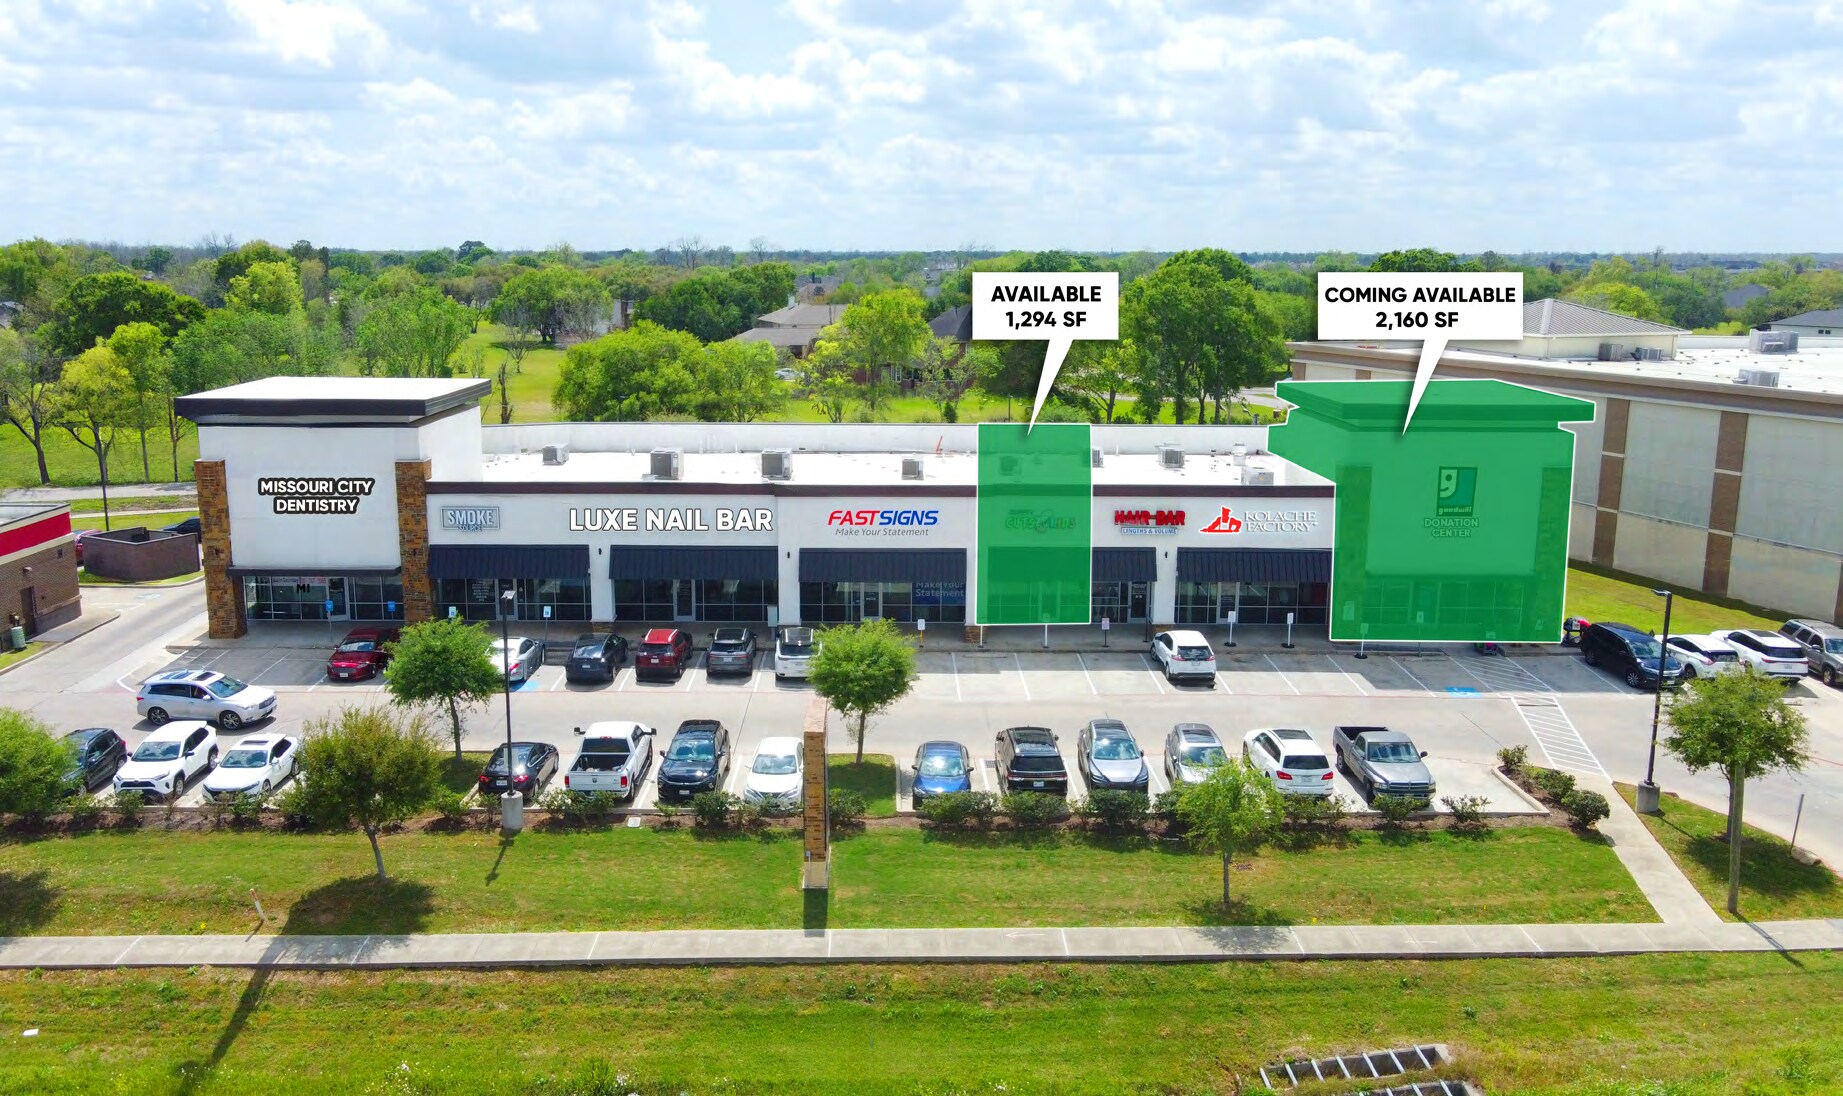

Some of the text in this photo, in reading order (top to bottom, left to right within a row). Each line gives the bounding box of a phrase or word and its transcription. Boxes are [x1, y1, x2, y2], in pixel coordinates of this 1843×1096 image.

[259, 479, 374, 495] MISSOURI CITY
[275, 498, 359, 513] DENTISTRY
[1438, 506, 1472, 516] goodwill
[447, 509, 494, 525] SMOKE
[568, 508, 774, 532] LUXE NAIL BAR
[827, 510, 940, 526] FASTSIGNS
[1114, 510, 1186, 525] HAIR BAR
[1244, 511, 1316, 522] KOLACHE
[1245, 522, 1314, 533] FACTORY
[1424, 518, 1479, 528] DONATION
[835, 528, 930, 536] Make Your Statement
[1432, 528, 1471, 537] CENTER
[915, 588, 965, 597] Statement
